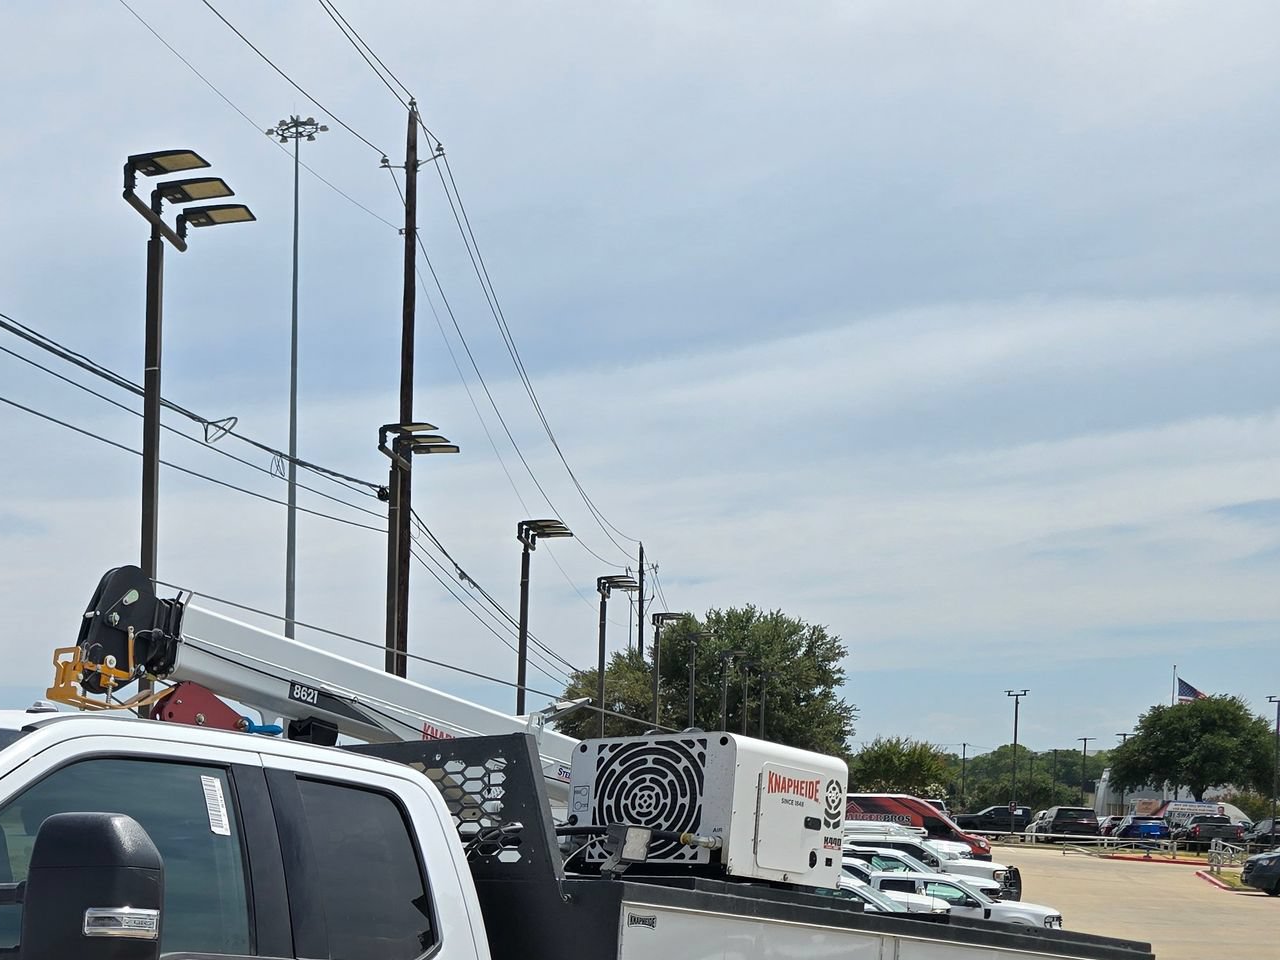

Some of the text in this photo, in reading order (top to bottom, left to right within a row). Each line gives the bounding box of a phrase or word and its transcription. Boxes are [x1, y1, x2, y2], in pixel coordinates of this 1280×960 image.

[294, 684, 318, 704] 8621
[768, 770, 820, 803] KNAPHEIDE
[781, 798, 794, 806] SINCE
